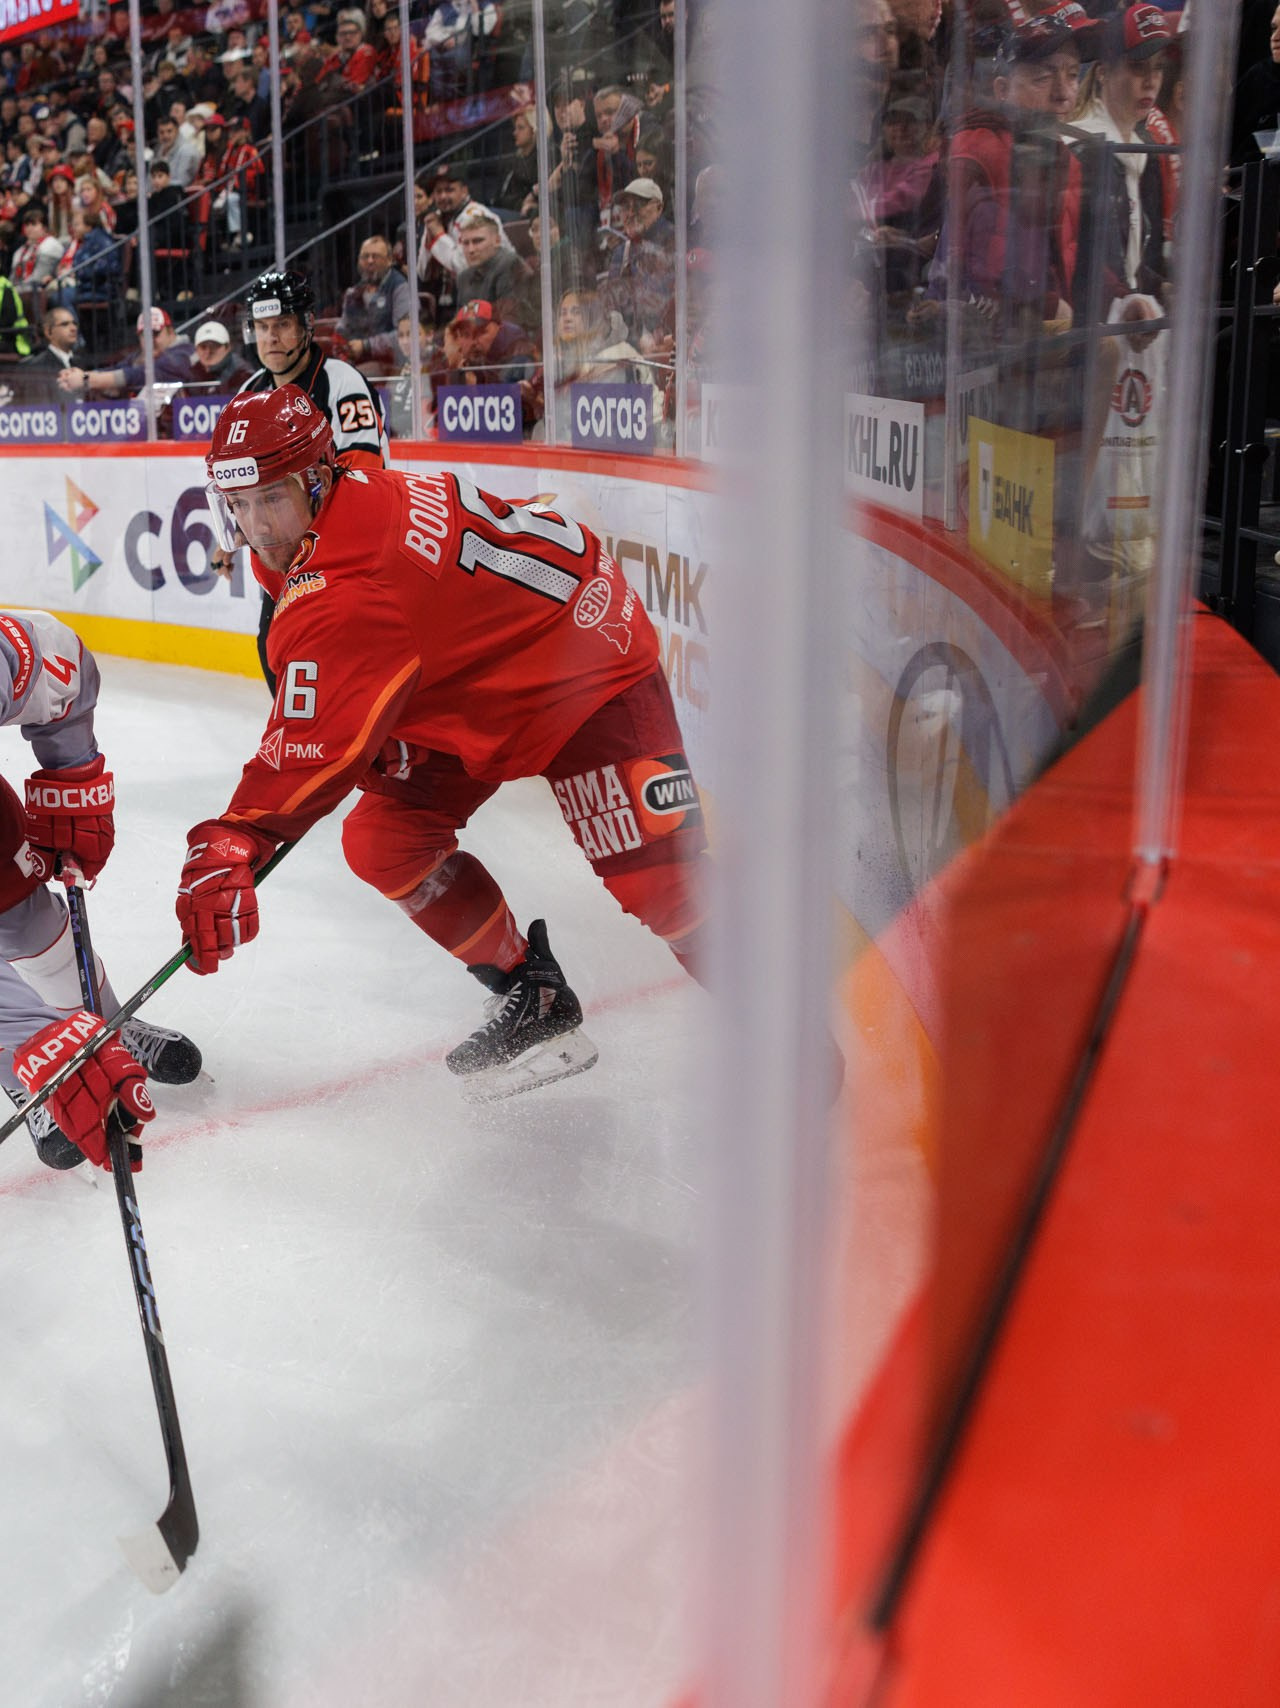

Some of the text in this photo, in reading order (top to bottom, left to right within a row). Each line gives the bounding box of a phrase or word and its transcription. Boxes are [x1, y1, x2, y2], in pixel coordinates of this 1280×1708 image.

[71, 404, 141, 436] согаз
[179, 404, 228, 434] сог
[339, 400, 376, 432] 25
[443, 395, 516, 432] согаз
[576, 395, 647, 441] согаз
[226, 420, 250, 445] 16
[848, 413, 919, 493] KHL.RU
[215, 465, 256, 480] согаз
[994, 475, 1035, 537] БАНК
[455, 473, 587, 606] 16
[579, 582, 608, 622] УЗТМ
[606, 535, 709, 637] ГМК
[43, 654, 78, 687] 4
[284, 743, 324, 759] РМК
[26, 782, 115, 808] МОСКВА
[554, 764, 631, 823] SIMA
[576, 806, 642, 860] AND
[229, 846, 249, 858] РМК
[17, 1010, 101, 1087] ПАРТАК
